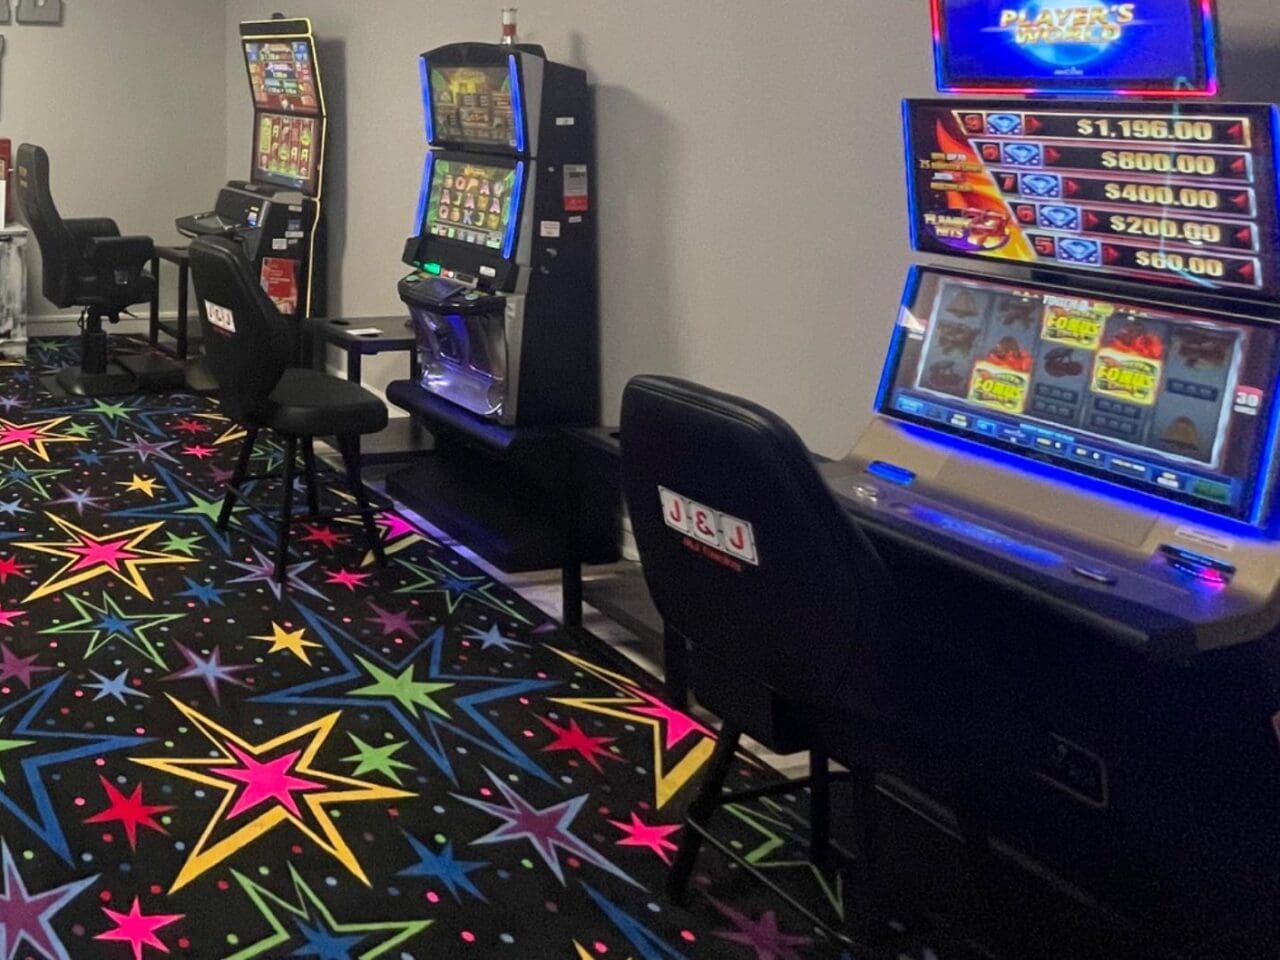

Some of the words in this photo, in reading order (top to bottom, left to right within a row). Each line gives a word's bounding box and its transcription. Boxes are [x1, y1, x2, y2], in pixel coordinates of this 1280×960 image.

[1000, 3, 1135, 28] PLAYER'S
[1015, 23, 1122, 44] WORLD
[1101, 150, 1216, 175] $800.00
[1104, 182, 1218, 209] $400.00
[1110, 214, 1221, 243] $200.00
[1135, 250, 1224, 277] $60.00
[1236, 391, 1258, 407] 30
